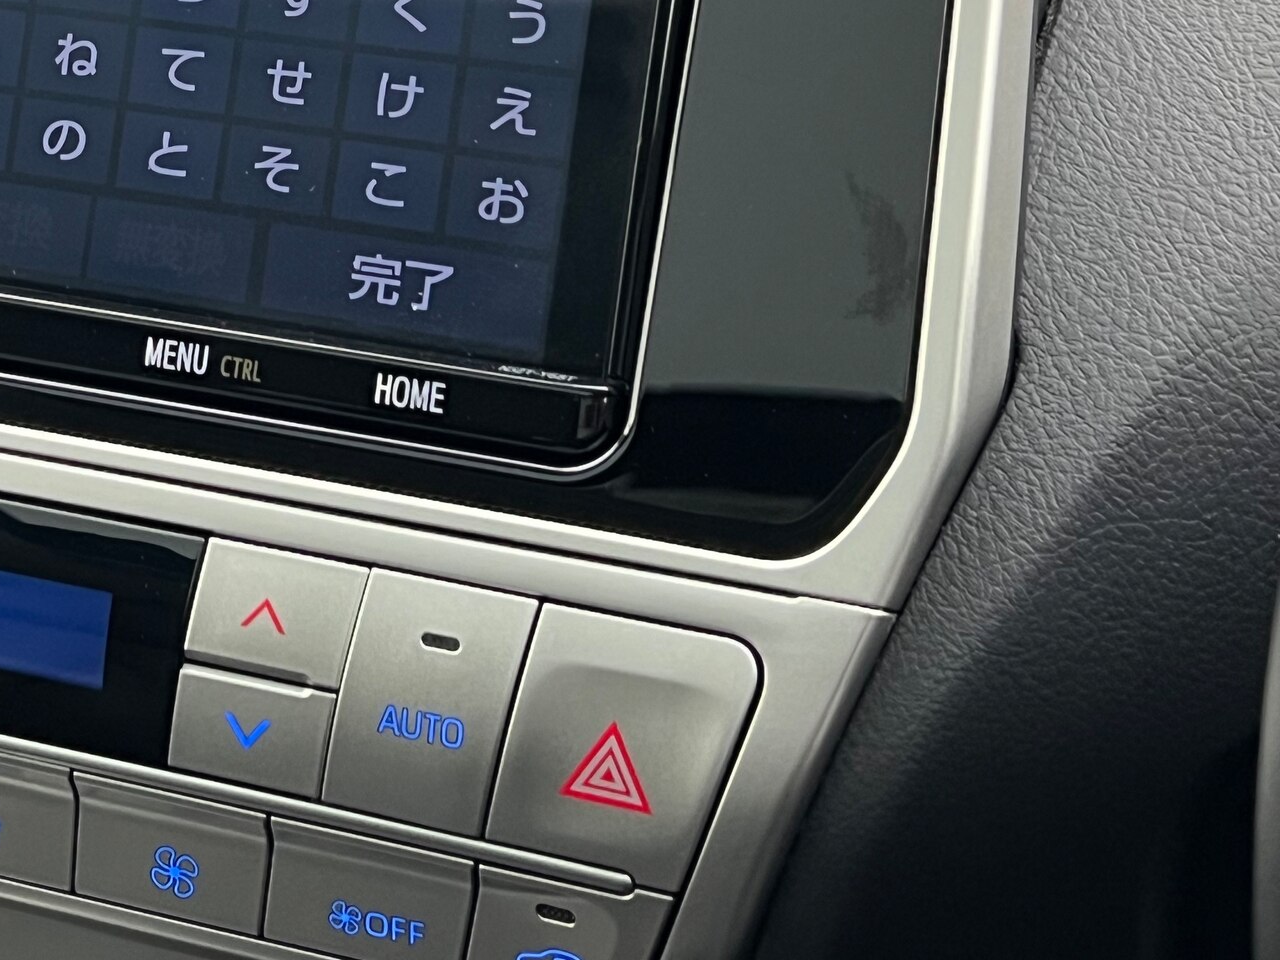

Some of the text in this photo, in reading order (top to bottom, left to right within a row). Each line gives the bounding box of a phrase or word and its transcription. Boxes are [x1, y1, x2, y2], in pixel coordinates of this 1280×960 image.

[54, 33, 98, 77] ね
[161, 47, 206, 92] て
[267, 59, 312, 106] せ
[376, 72, 425, 119] け
[489, 86, 537, 137] え
[42, 119, 87, 161] の
[147, 131, 189, 178] と
[254, 145, 300, 194] そ
[365, 162, 407, 207] こ
[477, 177, 529, 225] お
[348, 253, 455, 312] 完了
[144, 337, 262, 383] MENU CTRL
[373, 373, 446, 415] HOME
[377, 704, 464, 750] AUTO
[364, 913, 426, 945] OFF
